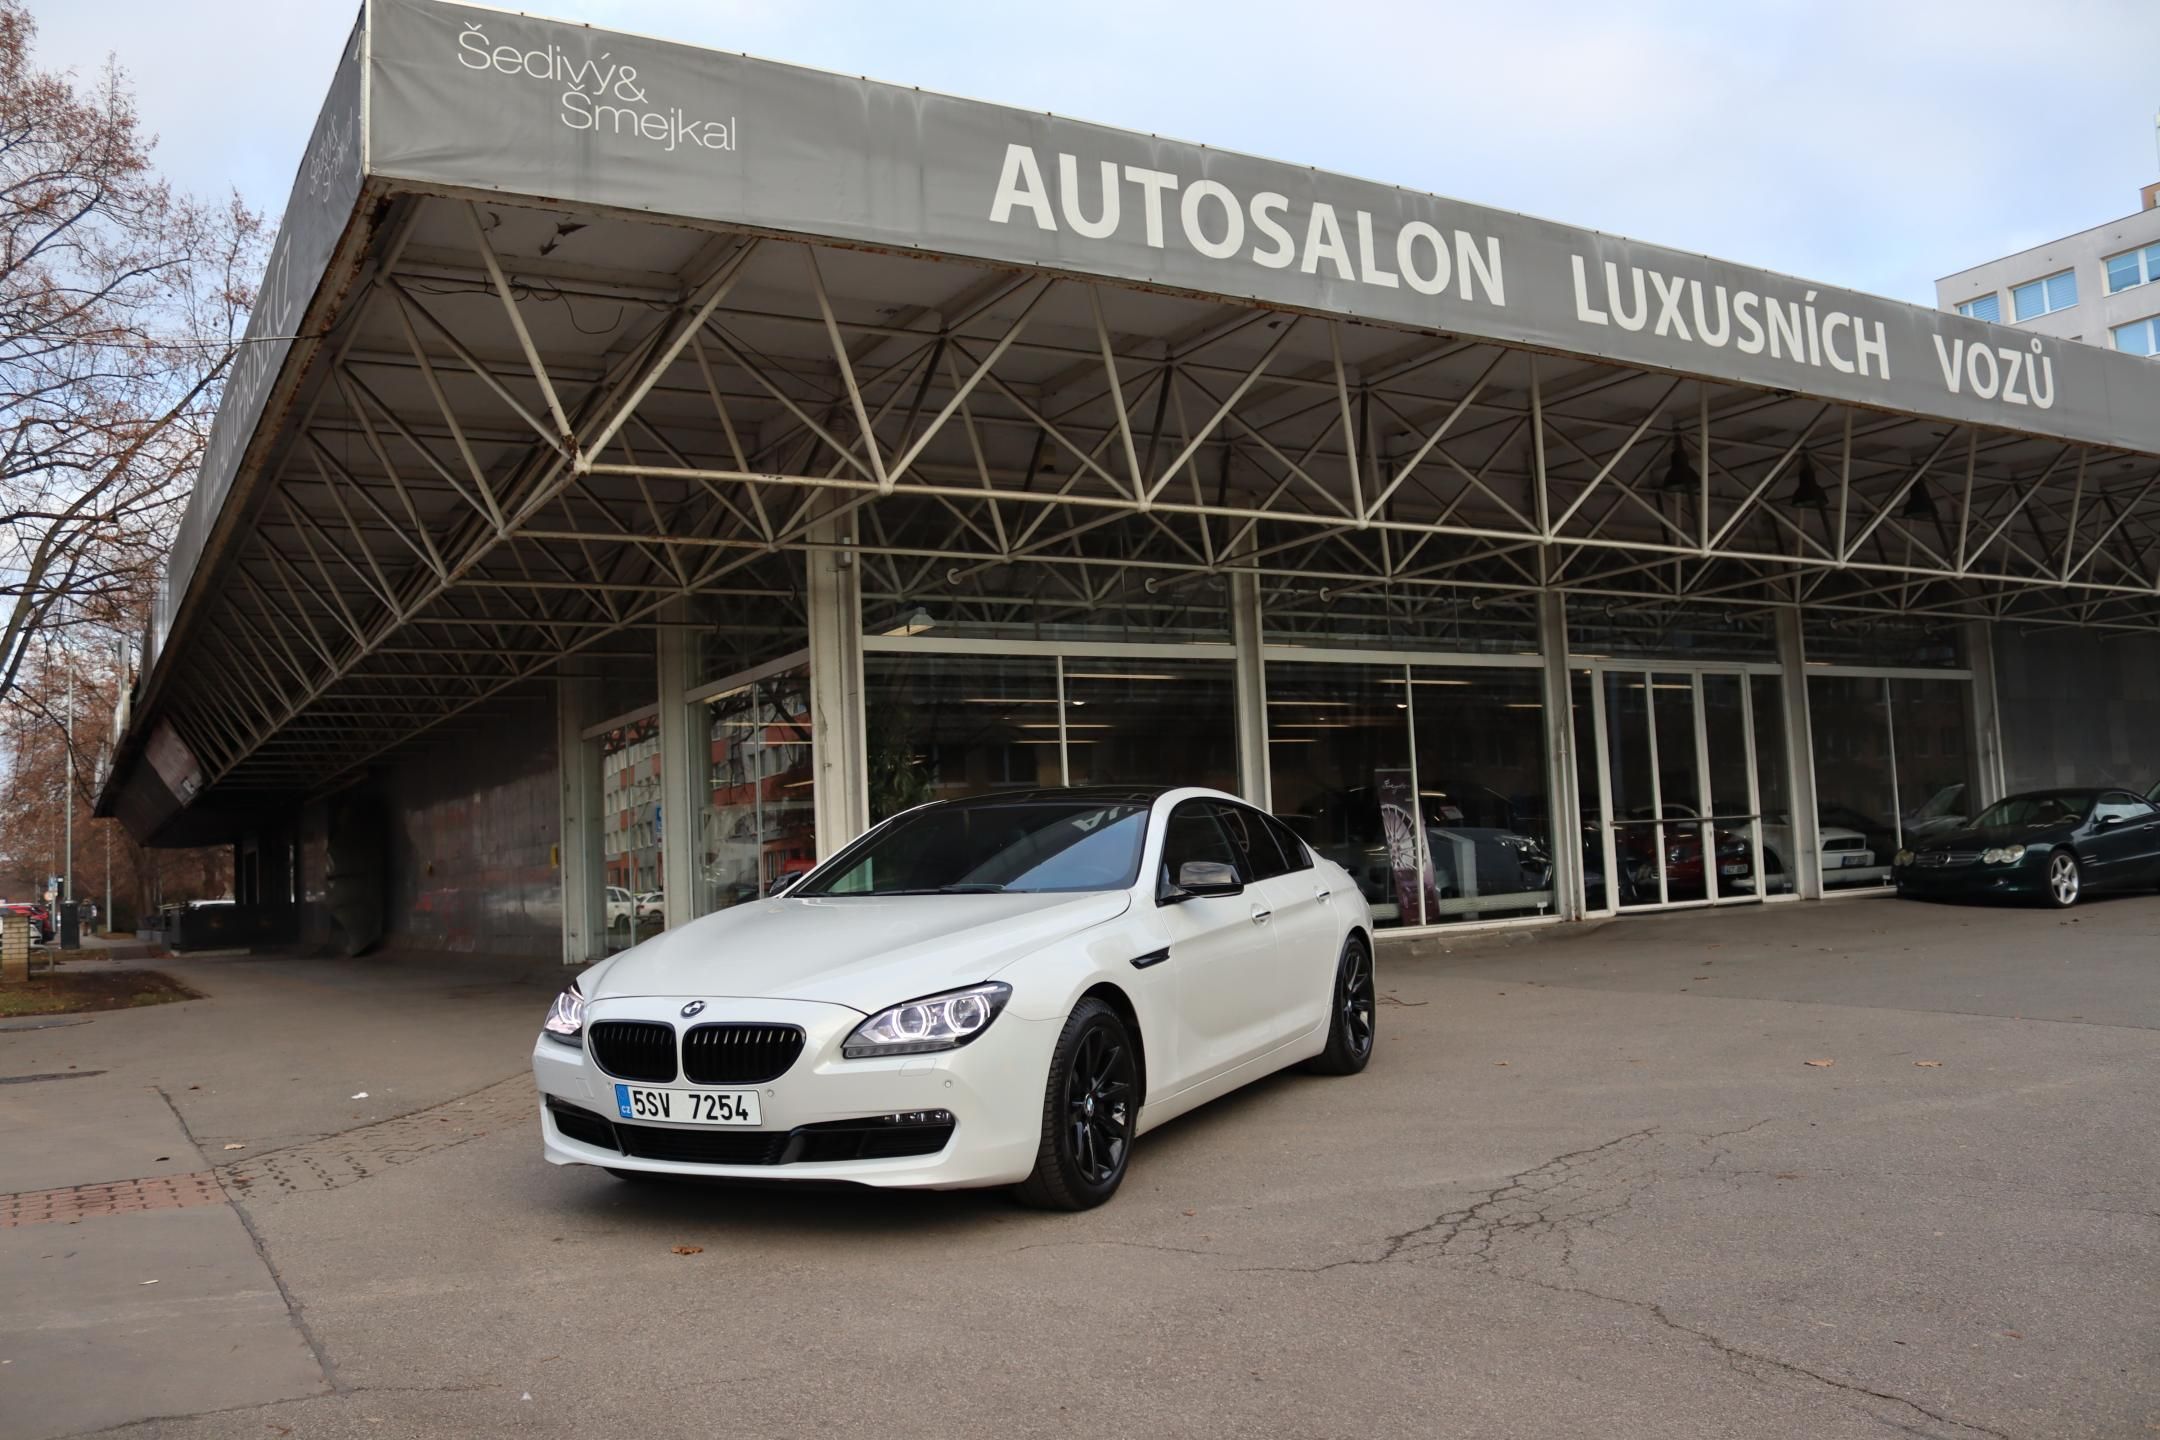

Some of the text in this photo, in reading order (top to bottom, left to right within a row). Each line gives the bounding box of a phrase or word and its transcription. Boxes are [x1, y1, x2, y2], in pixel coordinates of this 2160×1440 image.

[457, 20, 649, 104] Šedivý&
[560, 82, 737, 152] Šmejkal
[989, 143, 2055, 410] AUTOSALON LUXUSNÍCH VOZŮ
[621, 1090, 749, 1121] CZ 5SV 7254
